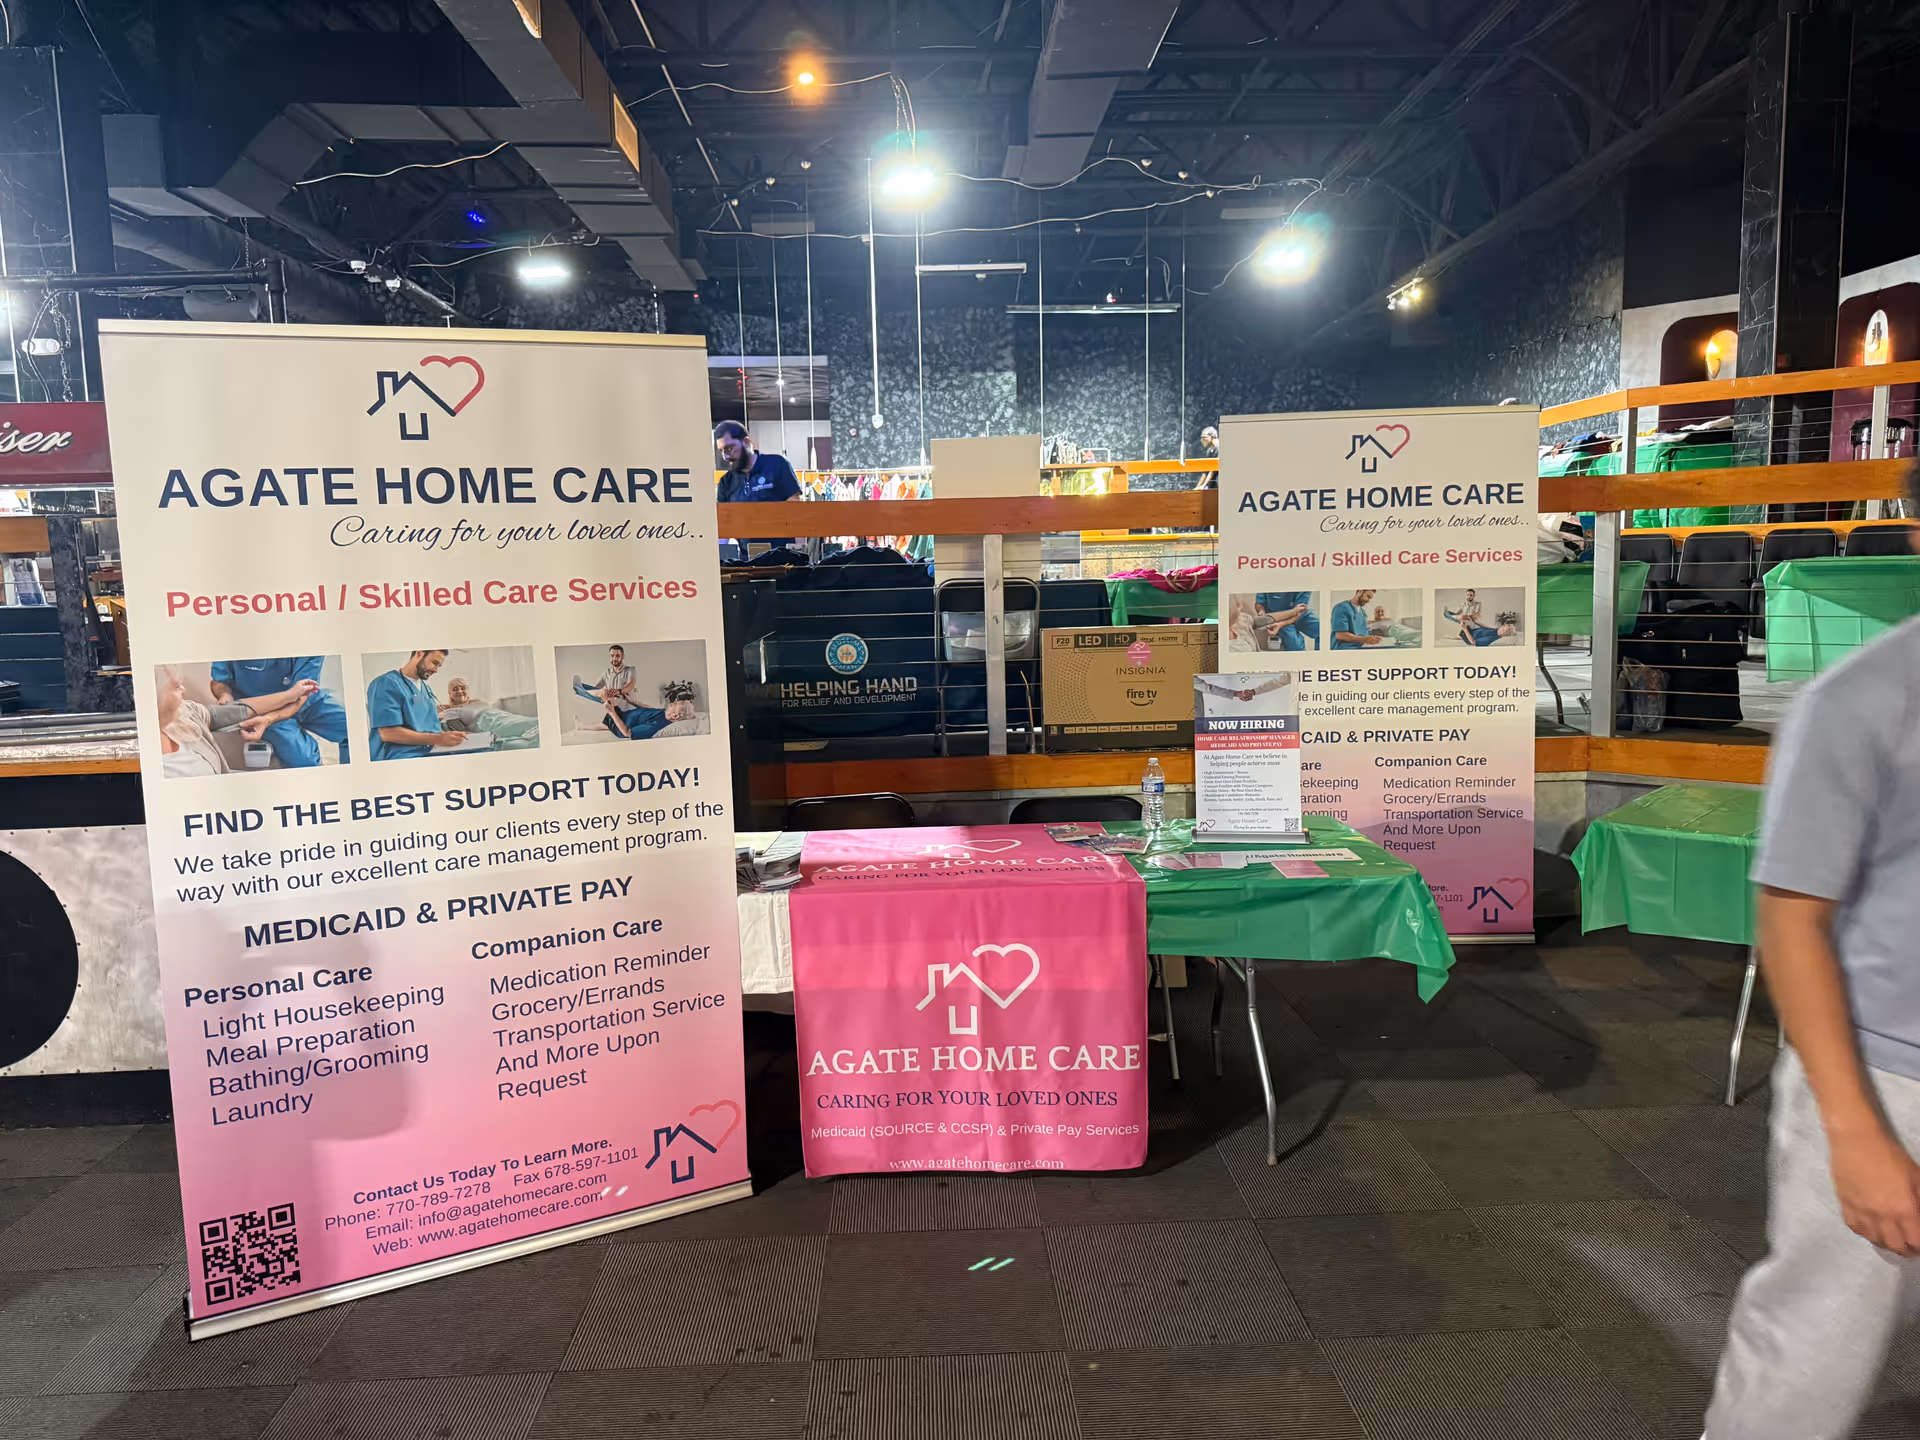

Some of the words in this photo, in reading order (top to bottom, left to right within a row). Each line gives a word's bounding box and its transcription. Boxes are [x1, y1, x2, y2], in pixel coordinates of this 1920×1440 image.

[158, 467, 358, 509] AGATE
[376, 467, 537, 505] HOME
[552, 467, 693, 504] CARE
[1238, 488, 1337, 513] AGATE
[1346, 485, 1433, 510] HOME
[1441, 482, 1525, 506] CARE
[330, 514, 444, 551] Caring
[441, 518, 492, 550] for
[496, 521, 561, 549] your
[566, 516, 631, 541] loved
[1319, 514, 1379, 534] Caring
[1376, 516, 1405, 534] for
[1408, 516, 1444, 533] your
[1447, 514, 1486, 528] loved
[1237, 552, 1316, 570] Personal
[1331, 550, 1392, 567] Skilled
[1397, 549, 1440, 565] Care
[1445, 547, 1524, 564] Services
[166, 585, 328, 618] Personal
[358, 580, 474, 609] Skilled
[482, 579, 558, 606] Care
[567, 575, 699, 603] Services
[1078, 635, 1102, 646] LED
[1114, 634, 1130, 644] HD
[1115, 666, 1166, 676] INSIGNIA
[1317, 669, 1362, 682] BEST
[1367, 667, 1449, 681] SUPPORT
[1453, 665, 1516, 679] TODAY!
[781, 679, 860, 698] HELPING
[866, 676, 918, 694] HAND
[782, 699, 799, 707] FOR
[802, 697, 831, 707] RELIEF
[833, 696, 852, 705] AND
[854, 692, 917, 704] DEVELOPMENT
[1126, 688, 1144, 699] fire
[1146, 689, 1158, 699] tv
[1325, 690, 1367, 704] guiding
[1371, 691, 1390, 701] our
[1393, 689, 1430, 701] clients
[1433, 690, 1466, 702] every
[1468, 688, 1494, 701] step
[1512, 687, 1530, 698] the
[1208, 720, 1238, 730] NOW
[1240, 719, 1285, 730] HIRING
[1304, 704, 1356, 716] excellent
[1358, 705, 1384, 715] care
[1387, 704, 1464, 717] management
[1467, 703, 1519, 716] program.
[1301, 731, 1342, 744] CAID
[1346, 731, 1359, 743] &
[1363, 729, 1434, 743] PRIVATE
[1439, 728, 1471, 742] PAY
[1375, 756, 1452, 769] Companion
[1456, 755, 1487, 766] Care
[1299, 776, 1359, 790] ekeeping
[1383, 777, 1451, 789] Medication
[1455, 776, 1516, 788] Reminder
[183, 808, 264, 838] FIND
[273, 801, 341, 828] THE
[350, 791, 435, 821] BEST
[444, 777, 590, 811] SUPPORT
[597, 766, 700, 796] TODAY!
[1383, 792, 1487, 806] Grocery/Errands
[1383, 808, 1473, 822] Transportation
[1477, 807, 1524, 819] Service
[174, 855, 214, 875] We
[222, 850, 272, 871] take
[280, 842, 336, 869] pride
[343, 839, 362, 857] in
[369, 832, 448, 858] guiding
[455, 827, 489, 845] our
[495, 819, 561, 840] clients
[567, 812, 621, 833] every
[626, 808, 666, 826] step
[672, 802, 690, 820] of
[694, 801, 724, 818] the
[1383, 824, 1408, 835] And
[1412, 824, 1444, 835] More
[1448, 824, 1481, 838] Upon
[1383, 840, 1436, 853] Request
[176, 883, 225, 904] way
[232, 874, 279, 897] with
[286, 871, 323, 890] our
[331, 856, 428, 885] excellent
[435, 853, 481, 872] care
[487, 836, 620, 867] management
[625, 828, 708, 854] program.
[811, 860, 918, 874] AGATE
[925, 858, 1027, 870] HOME
[1035, 855, 1124, 865] CARE
[244, 906, 406, 948] MEDICAID
[416, 902, 439, 924] &
[447, 884, 573, 920] PRIVATE
[581, 875, 633, 902] PAY
[471, 927, 606, 960] Companion
[612, 918, 663, 938] Care
[490, 963, 607, 995] Medication
[614, 944, 711, 975] Reminder
[184, 972, 304, 1007] Personal
[312, 966, 373, 988] Care
[491, 976, 666, 1021] Grocery/Errands
[203, 1011, 266, 1040] Light
[273, 986, 445, 1027] Housekeeping
[493, 1007, 646, 1048] Transportation
[652, 993, 726, 1019] Service
[206, 1039, 268, 1068] Meal
[276, 1018, 416, 1056] Preparation
[495, 1050, 539, 1076] And
[546, 1042, 600, 1066] More
[606, 1030, 660, 1055] Upon
[209, 1043, 430, 1097] Bathing/Grooming
[806, 1047, 921, 1077] AGATE
[931, 1045, 1038, 1073] HOME
[1048, 1044, 1141, 1072] CARE
[497, 1067, 588, 1101] Request
[817, 1093, 891, 1109] CARING
[896, 1091, 933, 1108] FOR
[937, 1090, 991, 1107] YOUR
[996, 1090, 1061, 1107] LOVED
[1065, 1090, 1118, 1106] ONES
[212, 1092, 314, 1126] Laundry
[811, 1126, 866, 1140] Medicaid
[870, 1122, 934, 1139] (SOURCE
[951, 1122, 994, 1137] CCSP)
[1010, 1122, 1054, 1136] Private
[1057, 1124, 1083, 1139] Pay
[1085, 1123, 1140, 1137] Services
[353, 1182, 419, 1206] Contact
[422, 1175, 445, 1190] Us
[449, 1164, 497, 1185] Today
[500, 1157, 520, 1172] To
[524, 1147, 568, 1168] Learn
[571, 1137, 613, 1157] More.
[889, 1155, 1065, 1170] www.agatehomecare.com
[324, 1206, 381, 1231] Phone:
[385, 1181, 492, 1217] 770-789-7278
[513, 1170, 541, 1187] Fax
[544, 1146, 639, 1180] 678-597-1101
[365, 1218, 414, 1240] Email:
[418, 1172, 608, 1228] info@agatehomecare.com
[372, 1237, 414, 1256] Web:
[417, 1190, 604, 1246] www.agatehomecare.com
